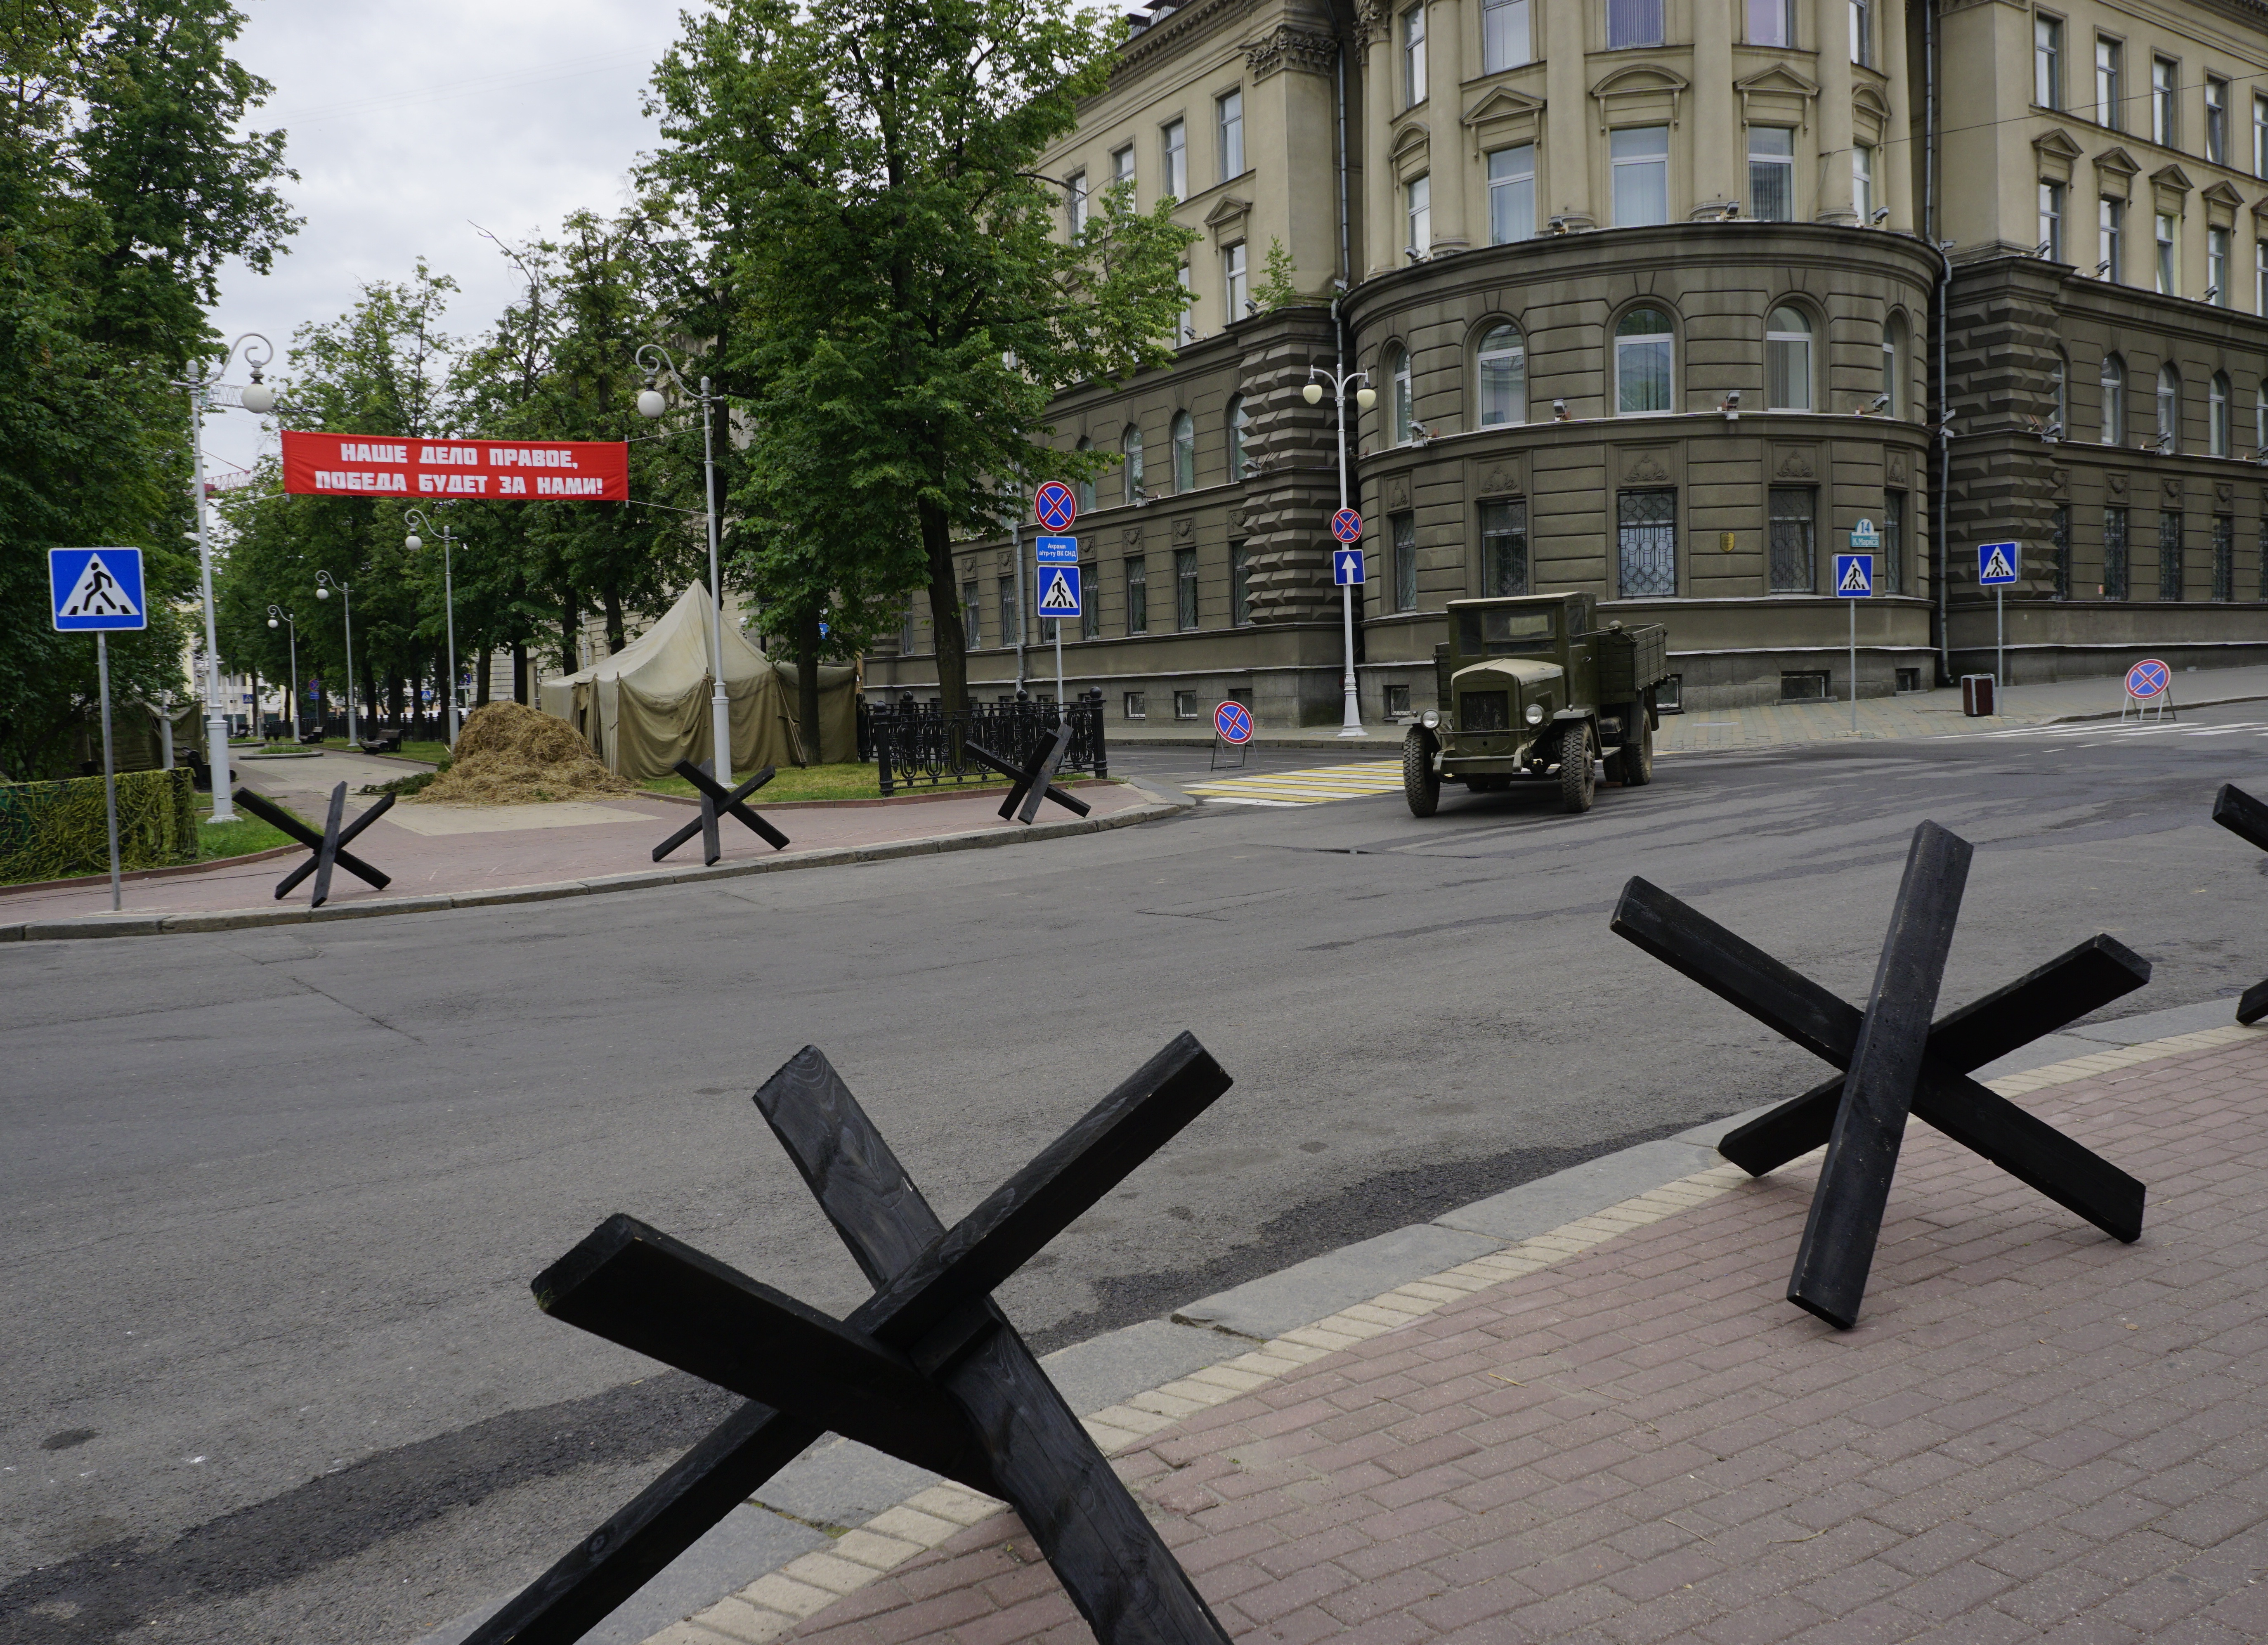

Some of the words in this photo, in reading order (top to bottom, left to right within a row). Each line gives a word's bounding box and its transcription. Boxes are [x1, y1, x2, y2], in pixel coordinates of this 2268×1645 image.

[340, 443, 408, 463] НАШЕ
[419, 446, 478, 465] ДЕЛО
[489, 448, 578, 469] ПРАВОЕ,
[315, 471, 407, 491] ПОБЕДА
[418, 474, 488, 493] БУДЕТ
[498, 476, 526, 494] ЗА
[537, 477, 603, 494] НАМИ!
[1861, 521, 1871, 534] 14
